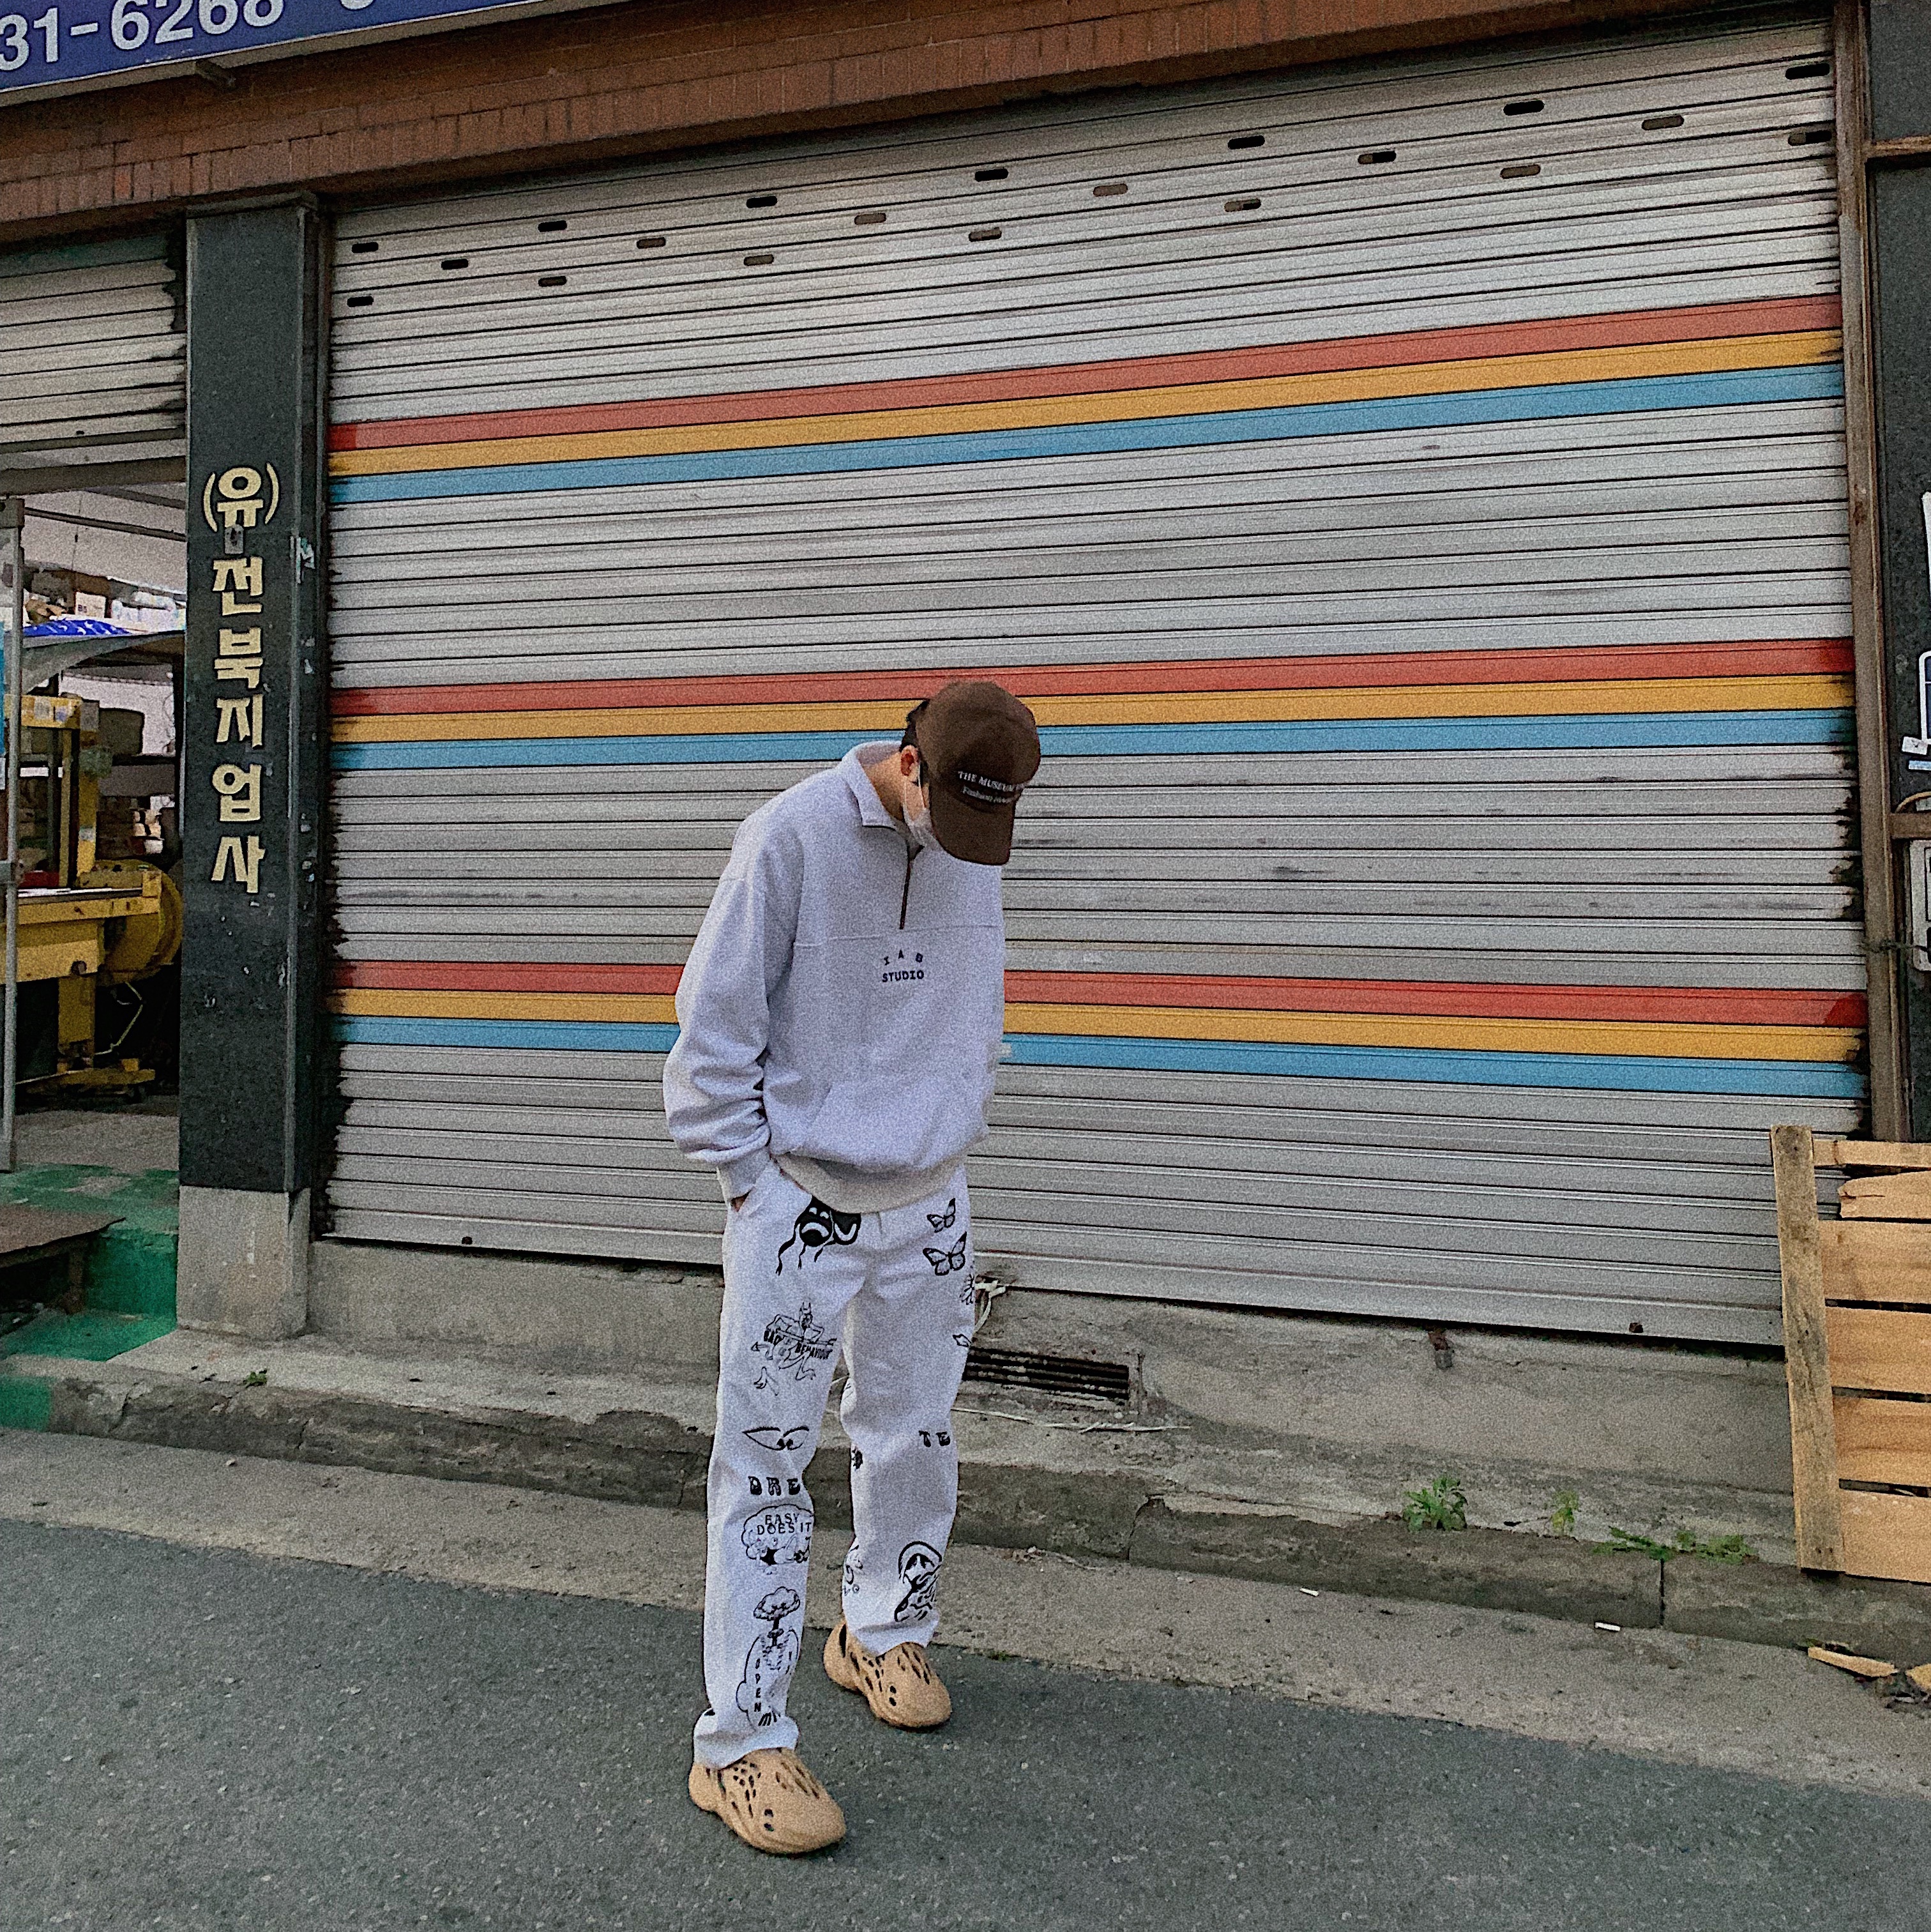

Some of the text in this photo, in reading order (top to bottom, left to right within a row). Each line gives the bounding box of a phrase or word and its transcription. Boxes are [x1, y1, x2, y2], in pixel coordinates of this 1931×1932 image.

[958, 771, 977, 782] THE
[882, 970, 924, 982] STUDIO
[765, 1513, 799, 1525] EASY
[757, 1522, 812, 1535] DOES IT
